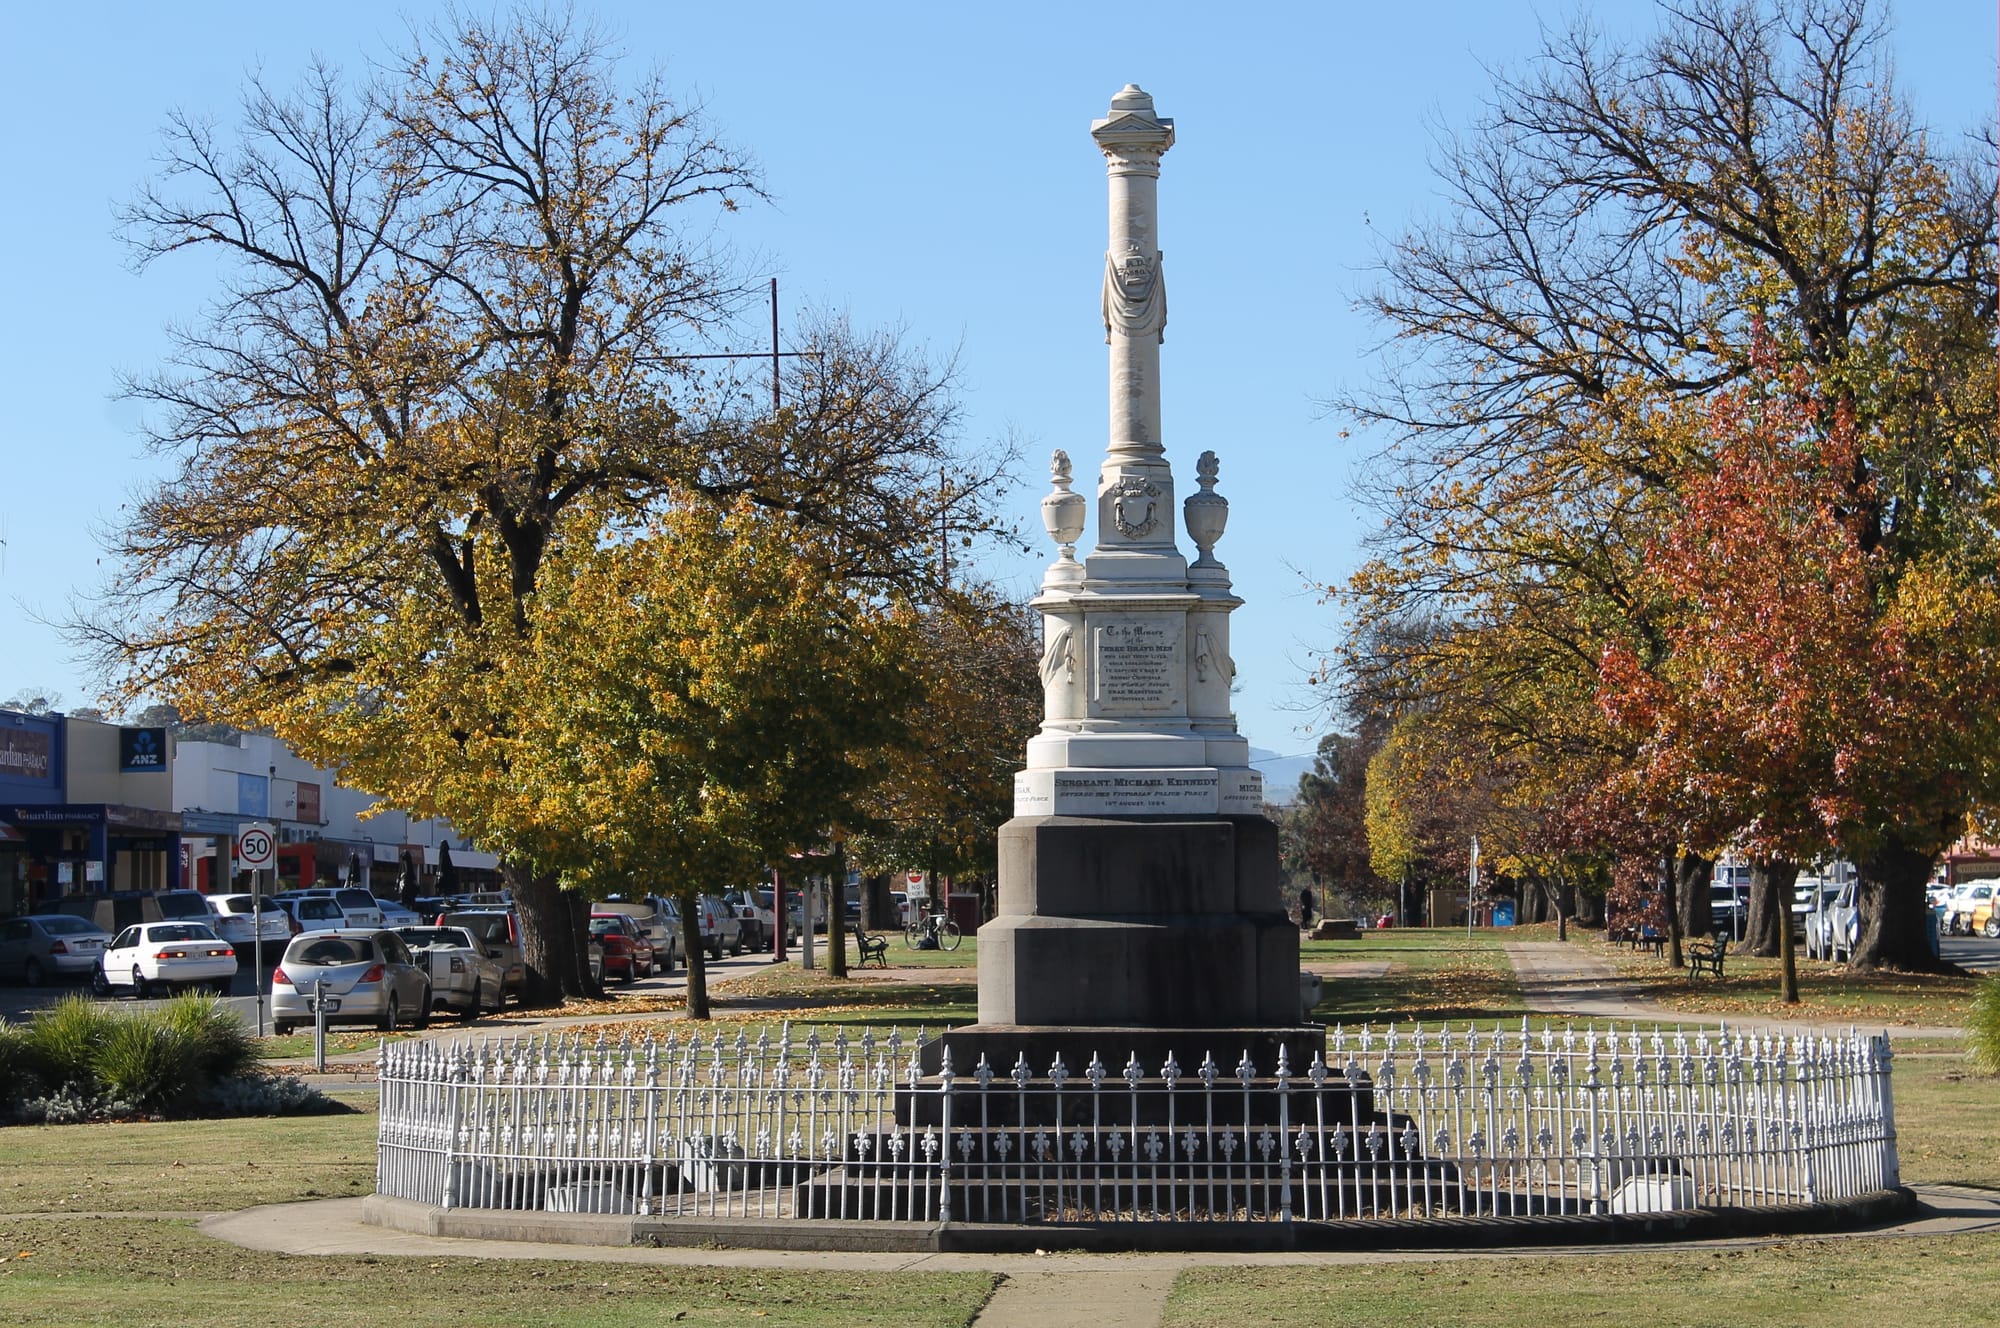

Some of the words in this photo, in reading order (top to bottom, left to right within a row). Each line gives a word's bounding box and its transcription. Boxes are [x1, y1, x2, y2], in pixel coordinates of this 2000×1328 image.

[1106, 625, 1119, 636] To
[130, 754, 158, 766] ANZ
[1114, 778, 1164, 787] MICHAEL
[16, 808, 63, 821] Guardian
[65, 812, 100, 820] PHARMACY
[245, 838, 268, 855] 50
